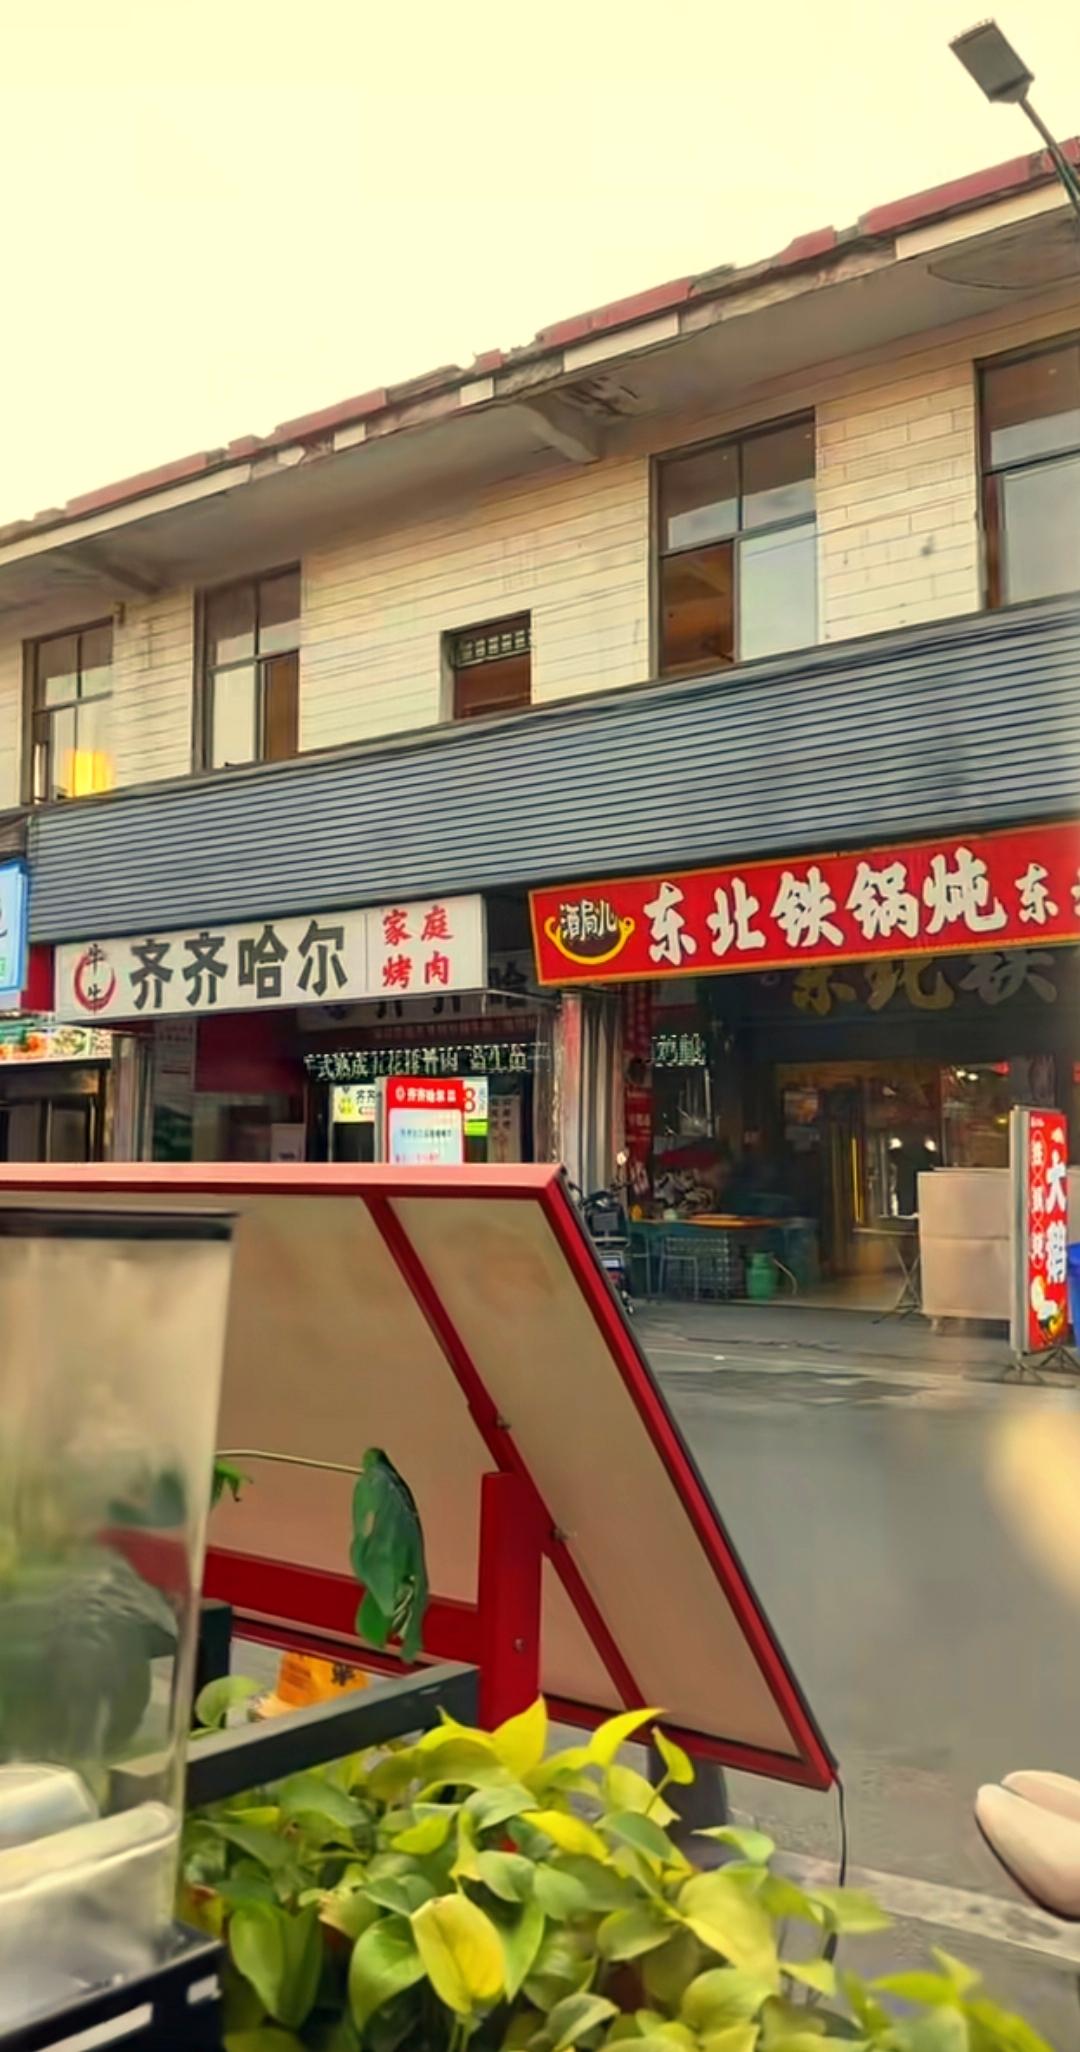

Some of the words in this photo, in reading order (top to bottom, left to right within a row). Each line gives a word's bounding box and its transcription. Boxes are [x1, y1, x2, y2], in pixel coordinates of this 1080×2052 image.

[382, 904, 454, 947] 家庭
[560, 899, 619, 941] 酒局儿
[642, 846, 1008, 966] 东北铁锅炖
[1014, 862, 1080, 924] 东
[129, 919, 348, 1010] 齐齐哈尔
[382, 951, 452, 990] 烤肉
